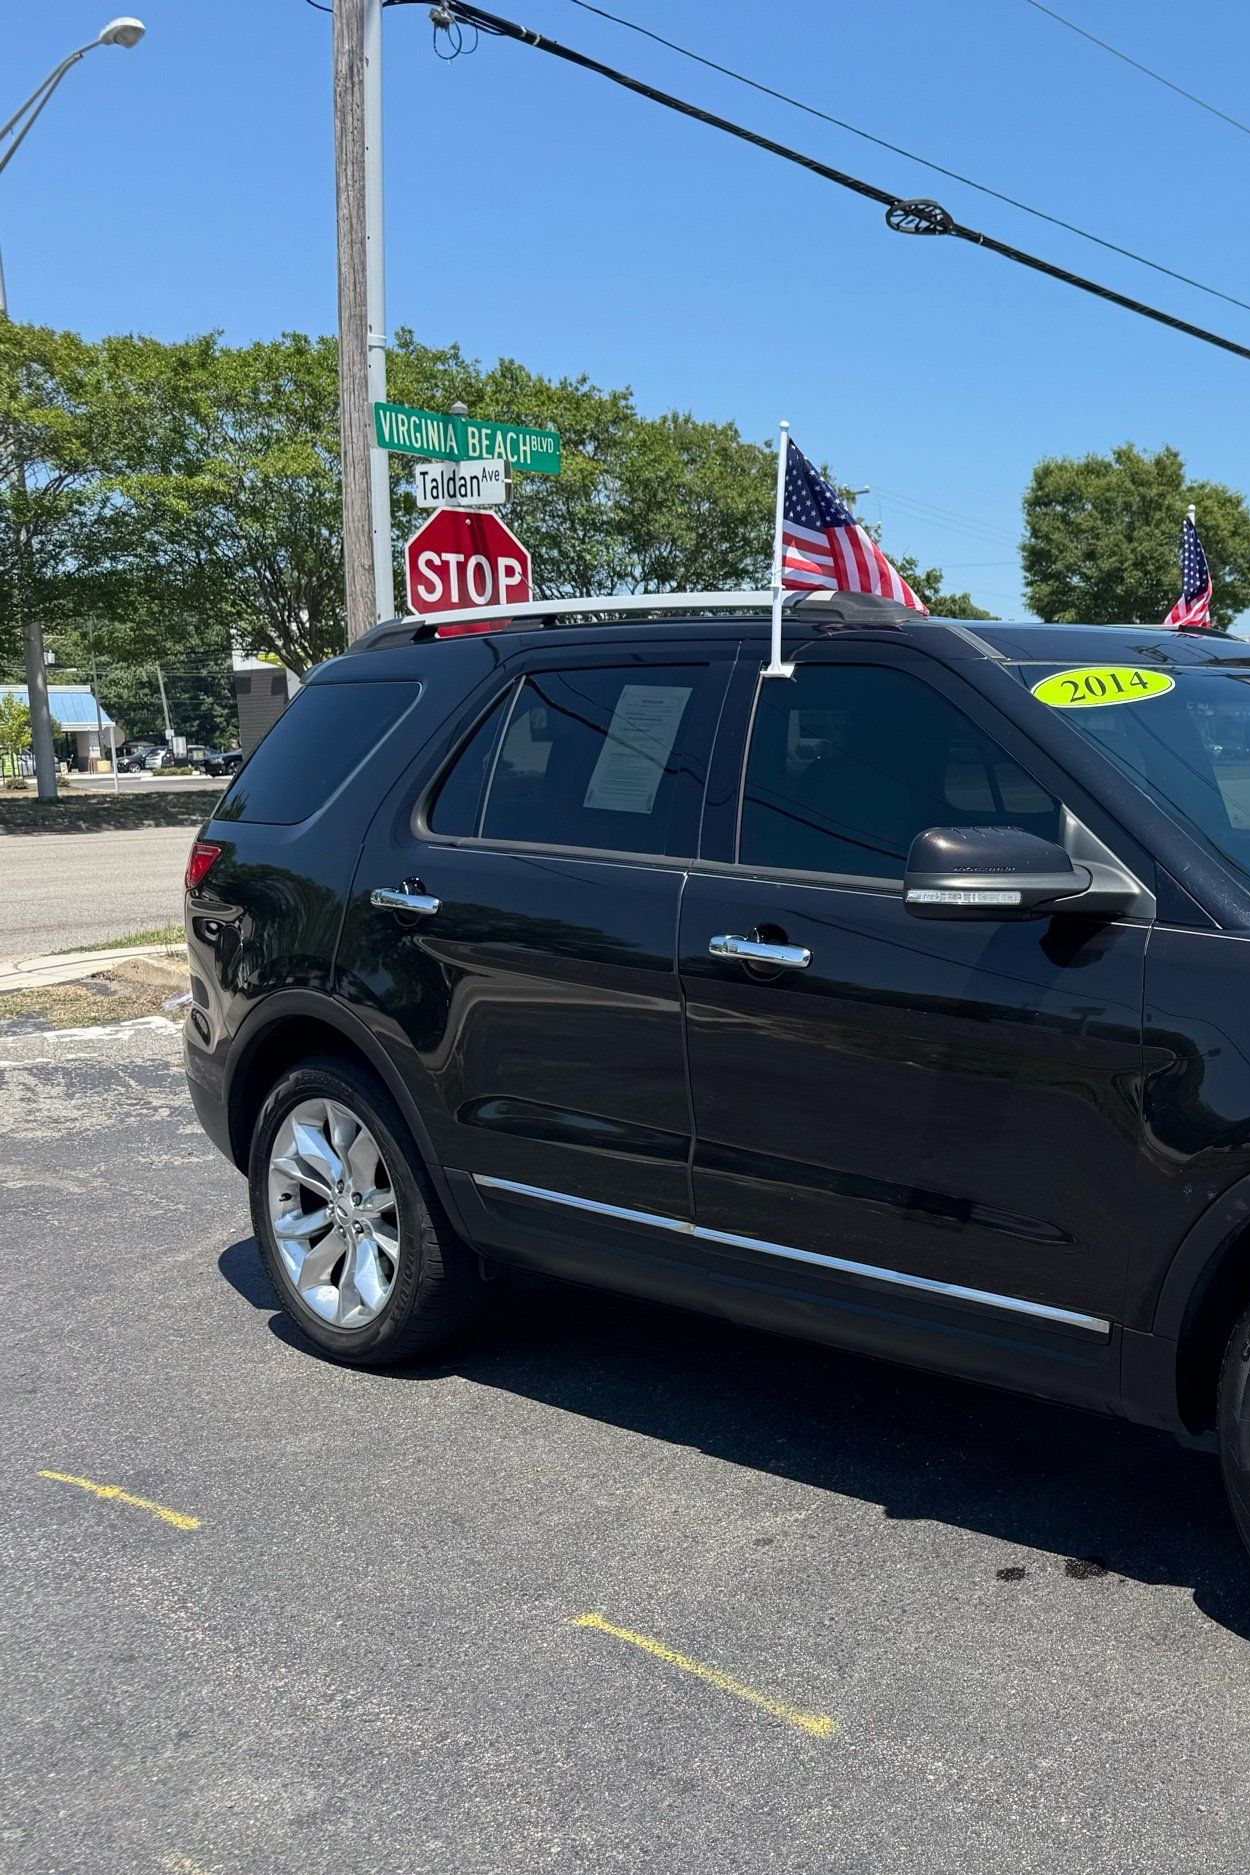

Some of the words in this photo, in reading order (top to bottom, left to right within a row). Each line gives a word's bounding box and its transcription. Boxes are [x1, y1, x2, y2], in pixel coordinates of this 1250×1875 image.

[378, 409, 458, 455] VIRGINIA
[467, 426, 532, 464] BEACH
[531, 435, 554, 453] BLVD
[420, 470, 481, 500] Taldan
[481, 466, 500, 483] Ave
[416, 550, 522, 605] STOP
[1060, 671, 1149, 703] 2014
